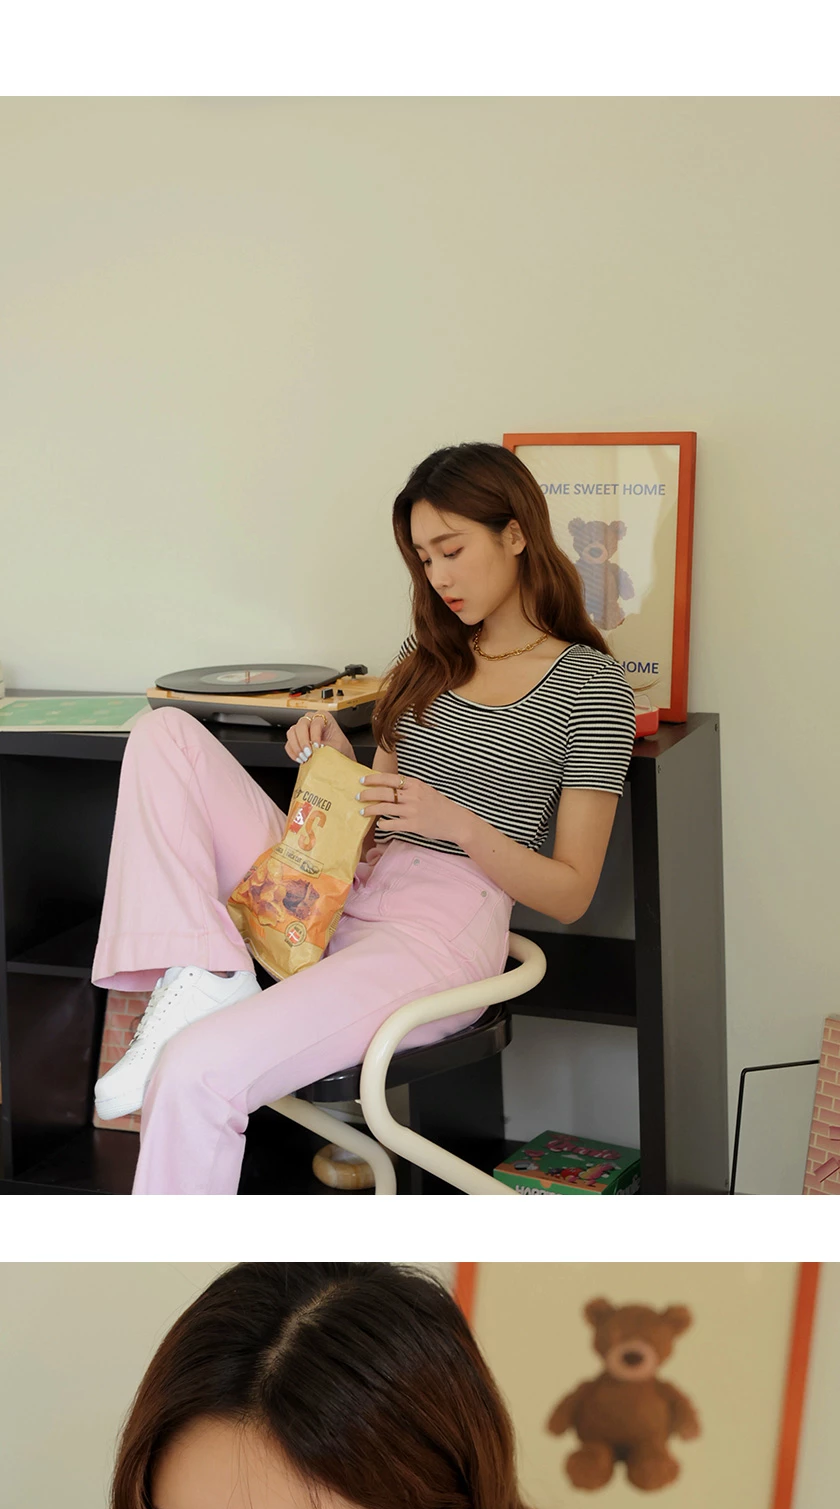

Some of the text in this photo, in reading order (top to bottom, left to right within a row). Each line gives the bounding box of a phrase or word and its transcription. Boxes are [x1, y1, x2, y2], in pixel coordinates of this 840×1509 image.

[541, 483, 666, 496] OME SWEET HOME
[302, 790, 332, 811] COOKED
